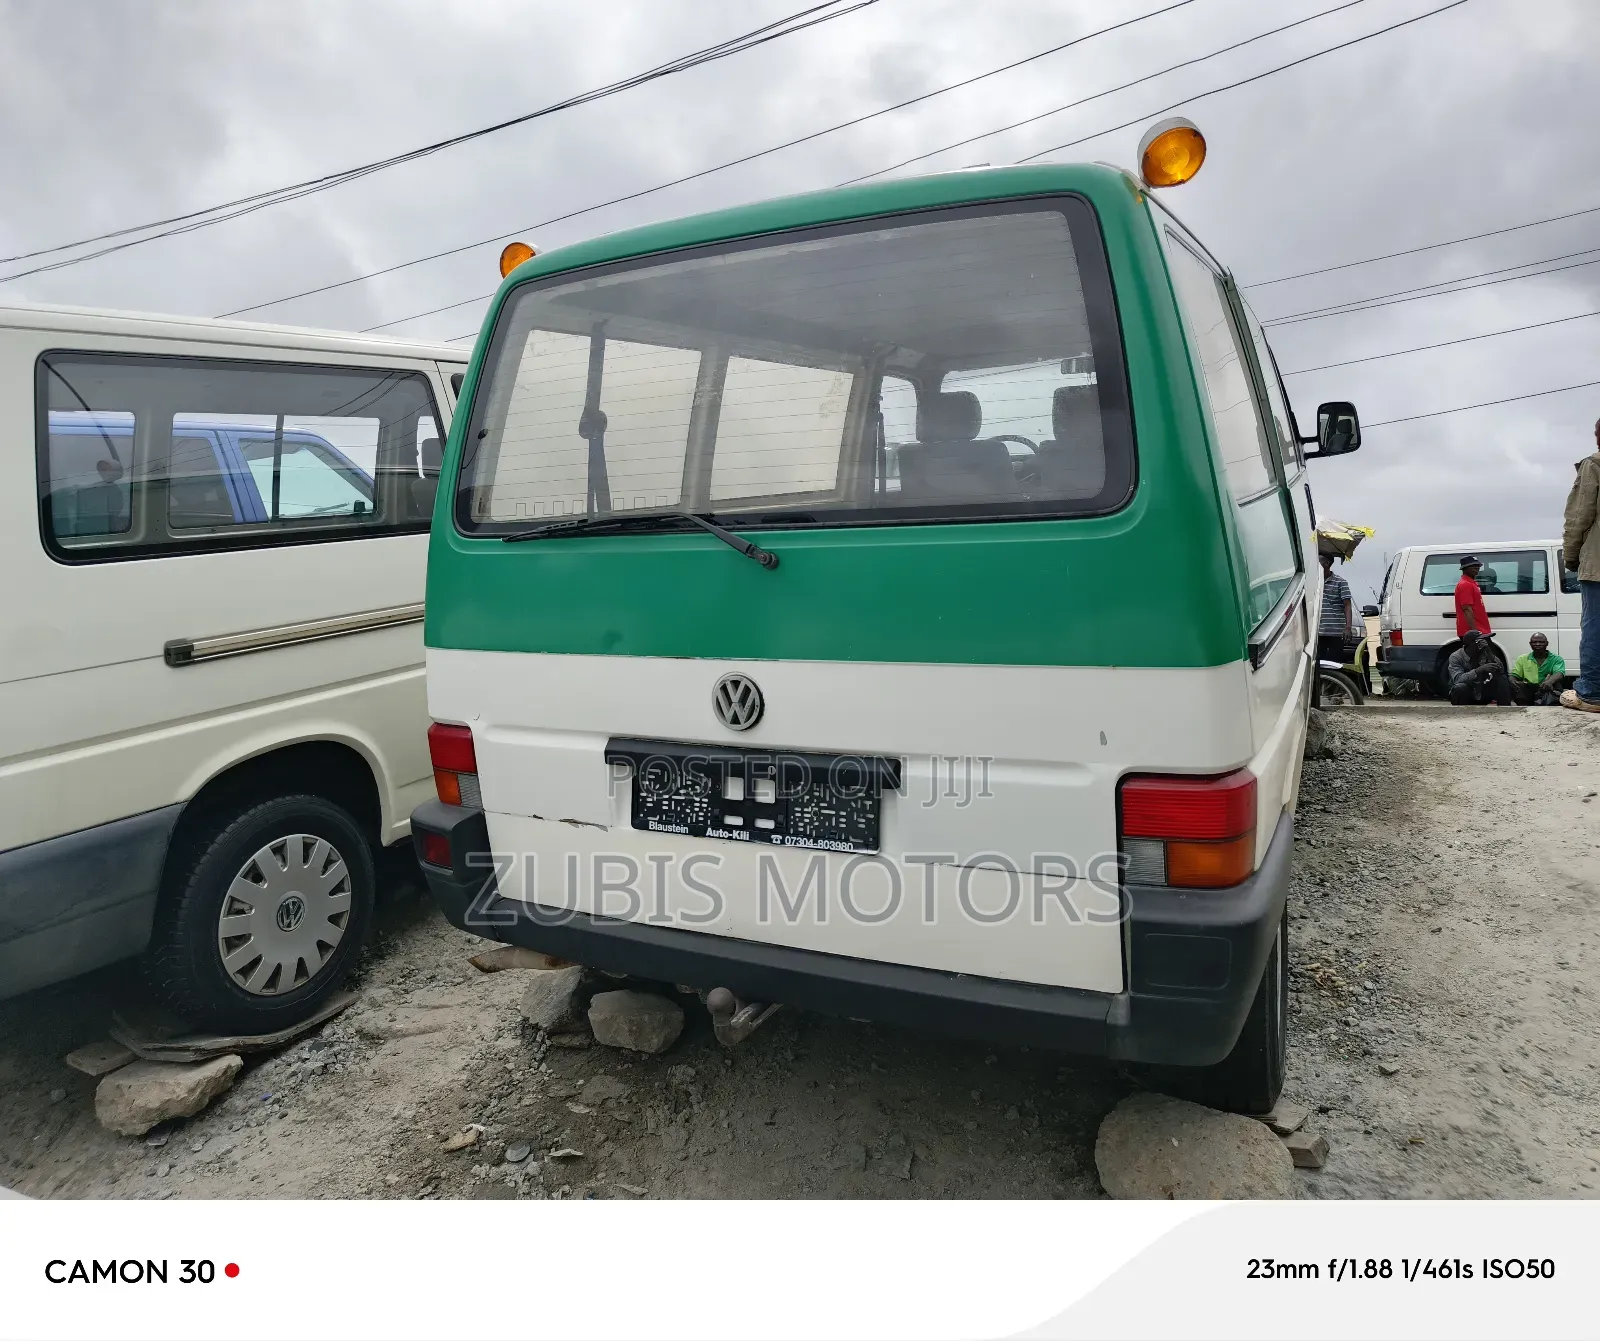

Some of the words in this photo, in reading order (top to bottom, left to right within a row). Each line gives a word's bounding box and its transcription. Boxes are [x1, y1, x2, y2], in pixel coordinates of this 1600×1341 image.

[648, 820, 689, 834] Blaustein
[705, 827, 750, 841] Auto-Kili
[784, 835, 854, 852] 07304-803980
